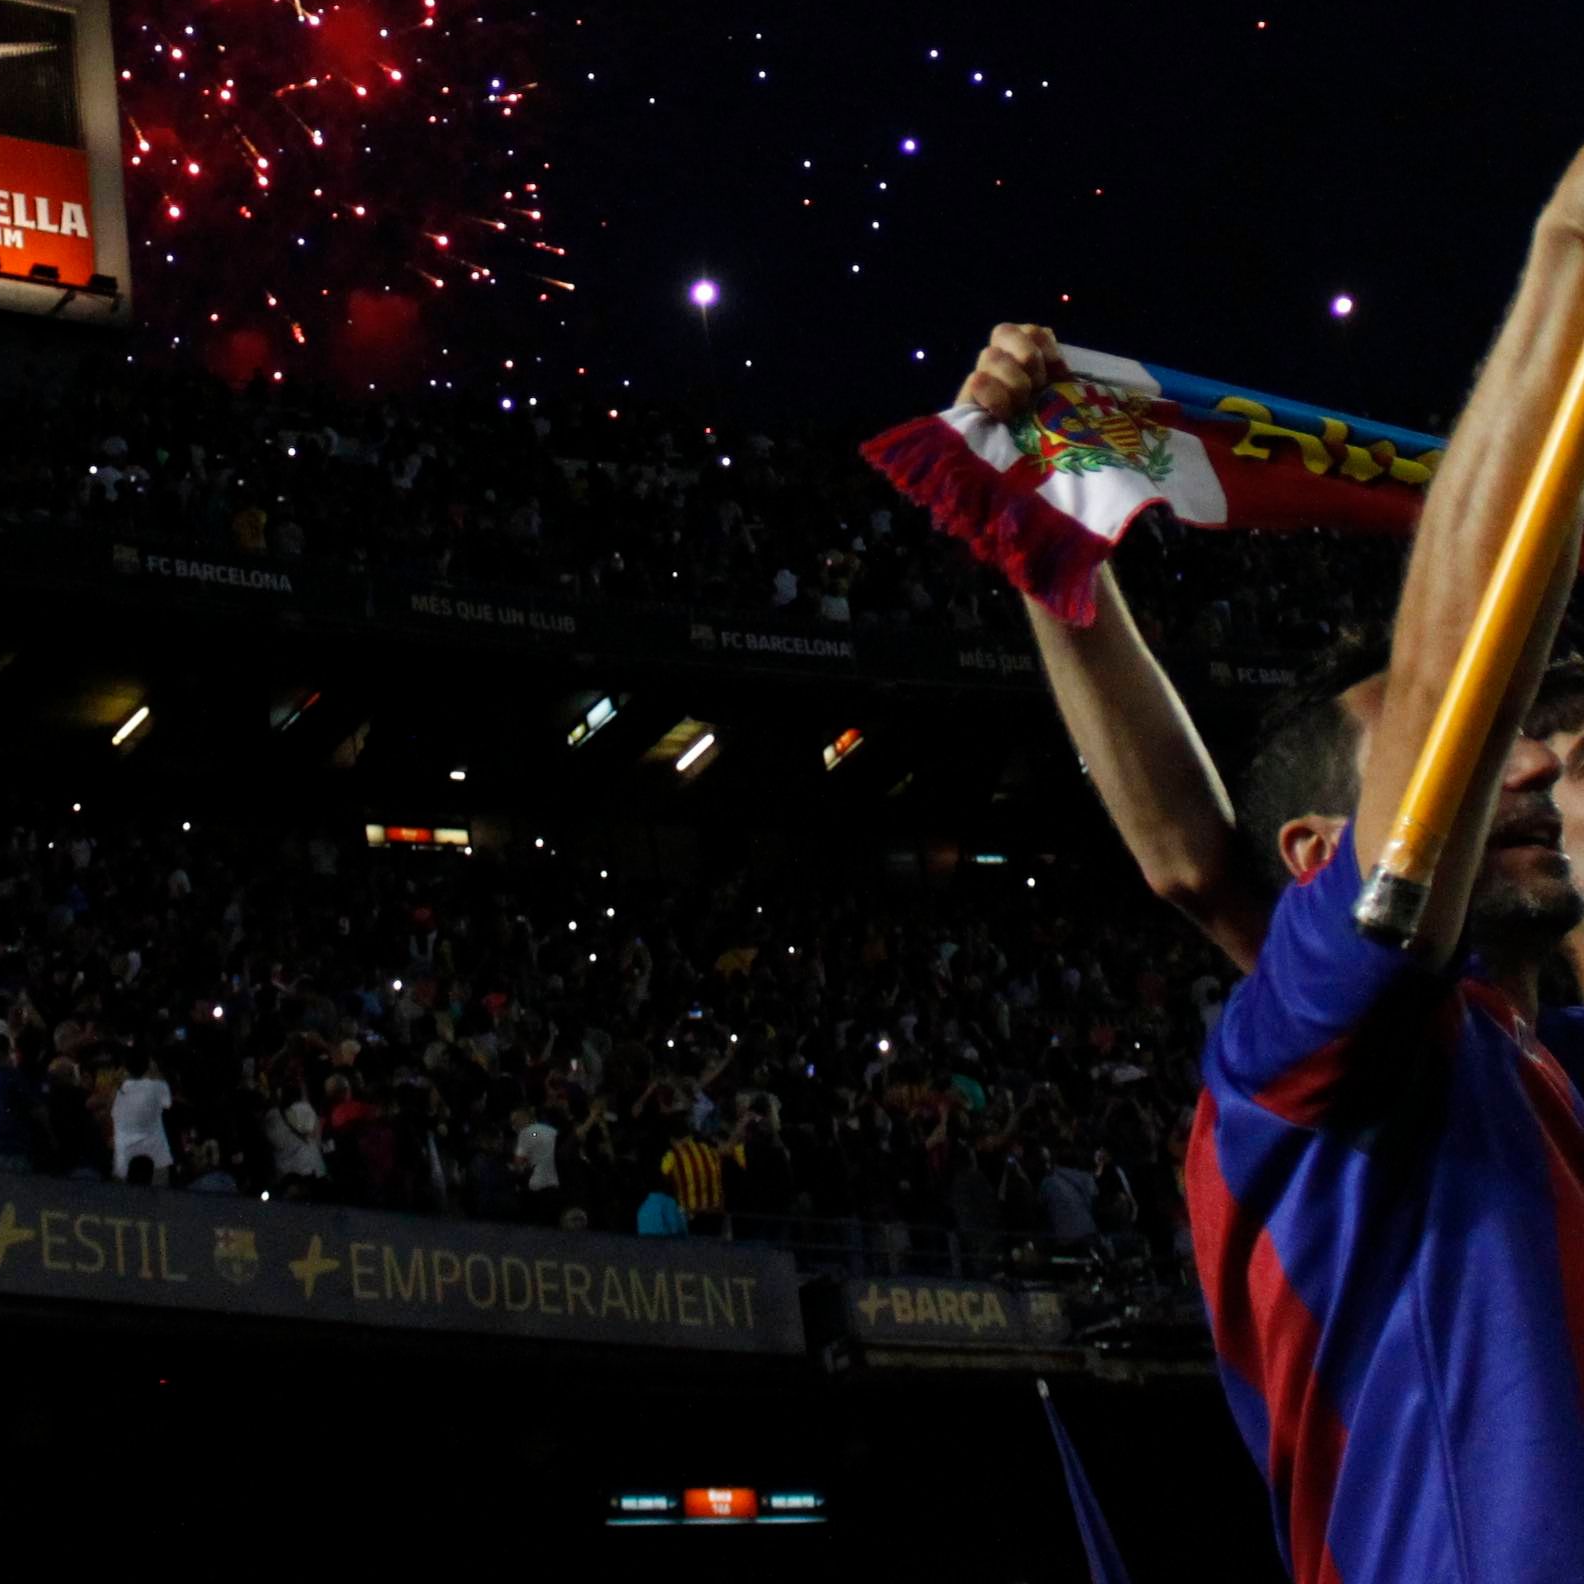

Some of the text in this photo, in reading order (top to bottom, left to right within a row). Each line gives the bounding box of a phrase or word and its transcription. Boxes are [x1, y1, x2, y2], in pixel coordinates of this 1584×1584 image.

[147, 554, 293, 593] FC BARCELONA
[721, 631, 853, 658] FC BARCELONA
